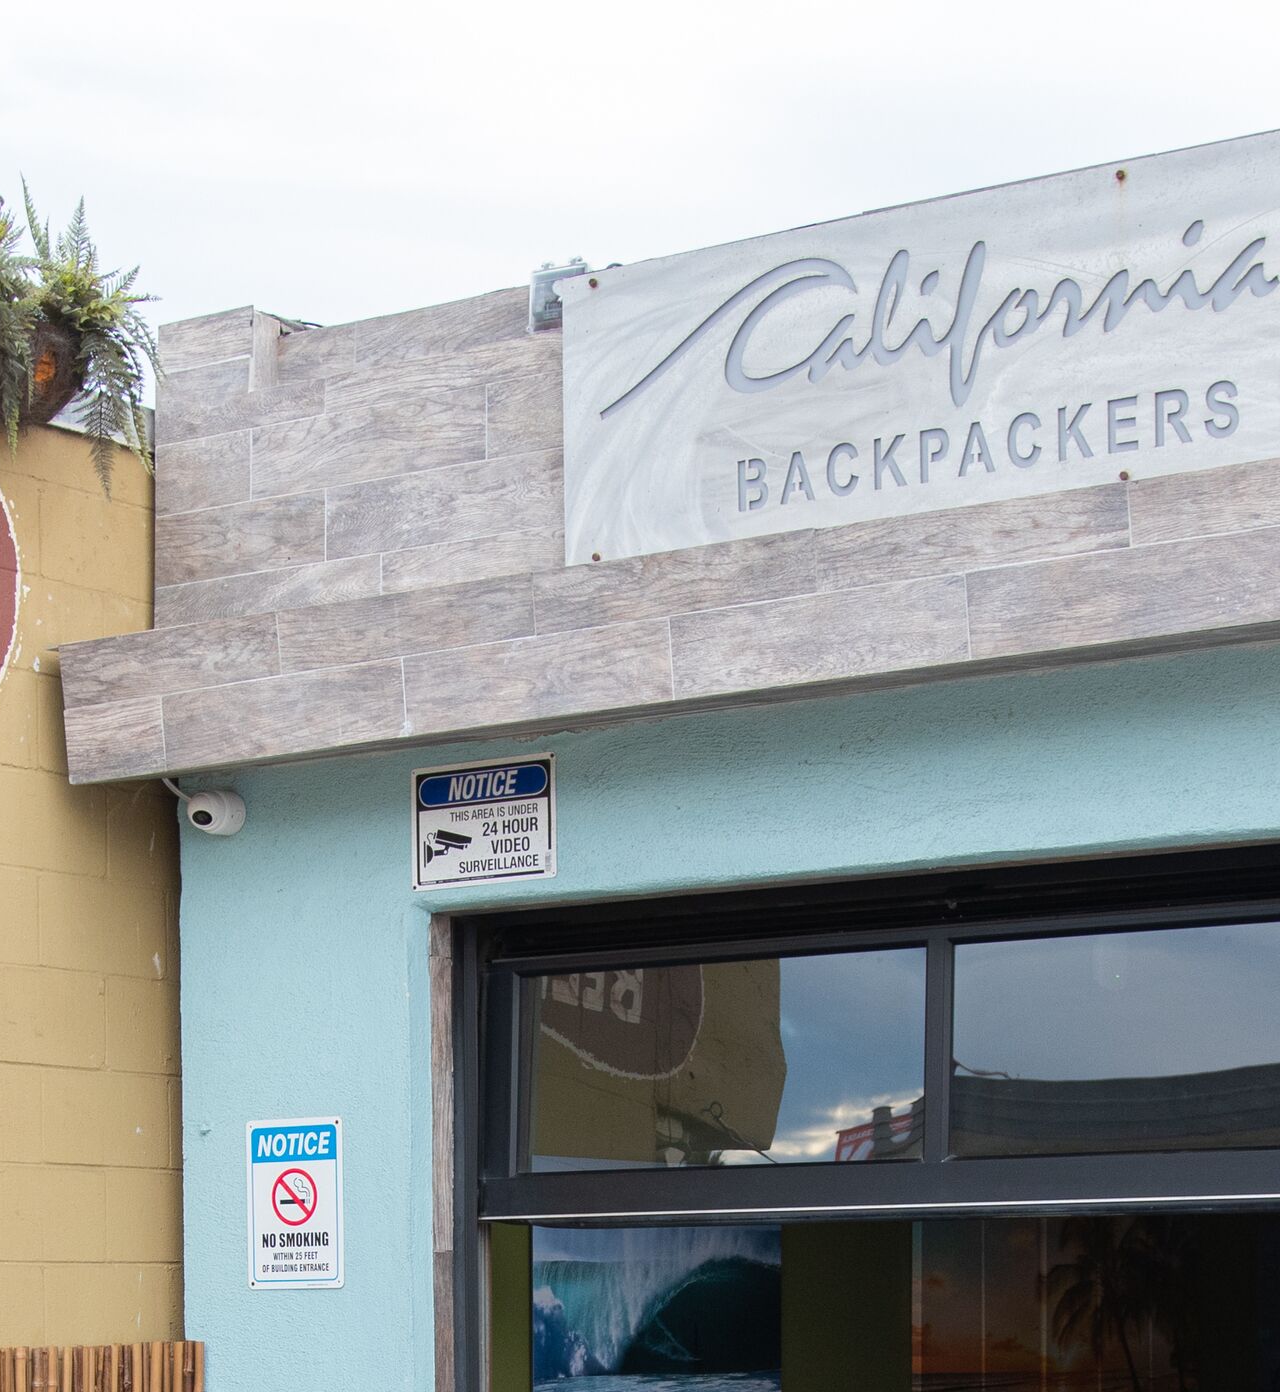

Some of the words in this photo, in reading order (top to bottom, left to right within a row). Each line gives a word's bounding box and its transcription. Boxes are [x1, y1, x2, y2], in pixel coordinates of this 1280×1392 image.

[600, 217, 1280, 413] California
[737, 378, 1240, 513] BACKPACKERS
[448, 769, 519, 802] NOTICE
[450, 811, 470, 822] THIS
[471, 808, 495, 820] AREA
[497, 806, 506, 817] IS
[508, 803, 538, 815] UNDER
[482, 821, 499, 837] 24
[502, 816, 538, 834] HOUR
[491, 836, 530, 854] VIDEO
[458, 854, 539, 874] SURVEILLANCE
[257, 1131, 331, 1158] NOTICE
[262, 1233, 276, 1248] NO
[279, 1231, 329, 1248] SMOKING
[273, 1251, 294, 1261] WITHIN
[295, 1251, 303, 1260] 25
[304, 1251, 318, 1260] FEET
[262, 1264, 270, 1273] OF
[271, 1263, 298, 1273] BUILDING
[299, 1262, 330, 1272] ENTRANCE
